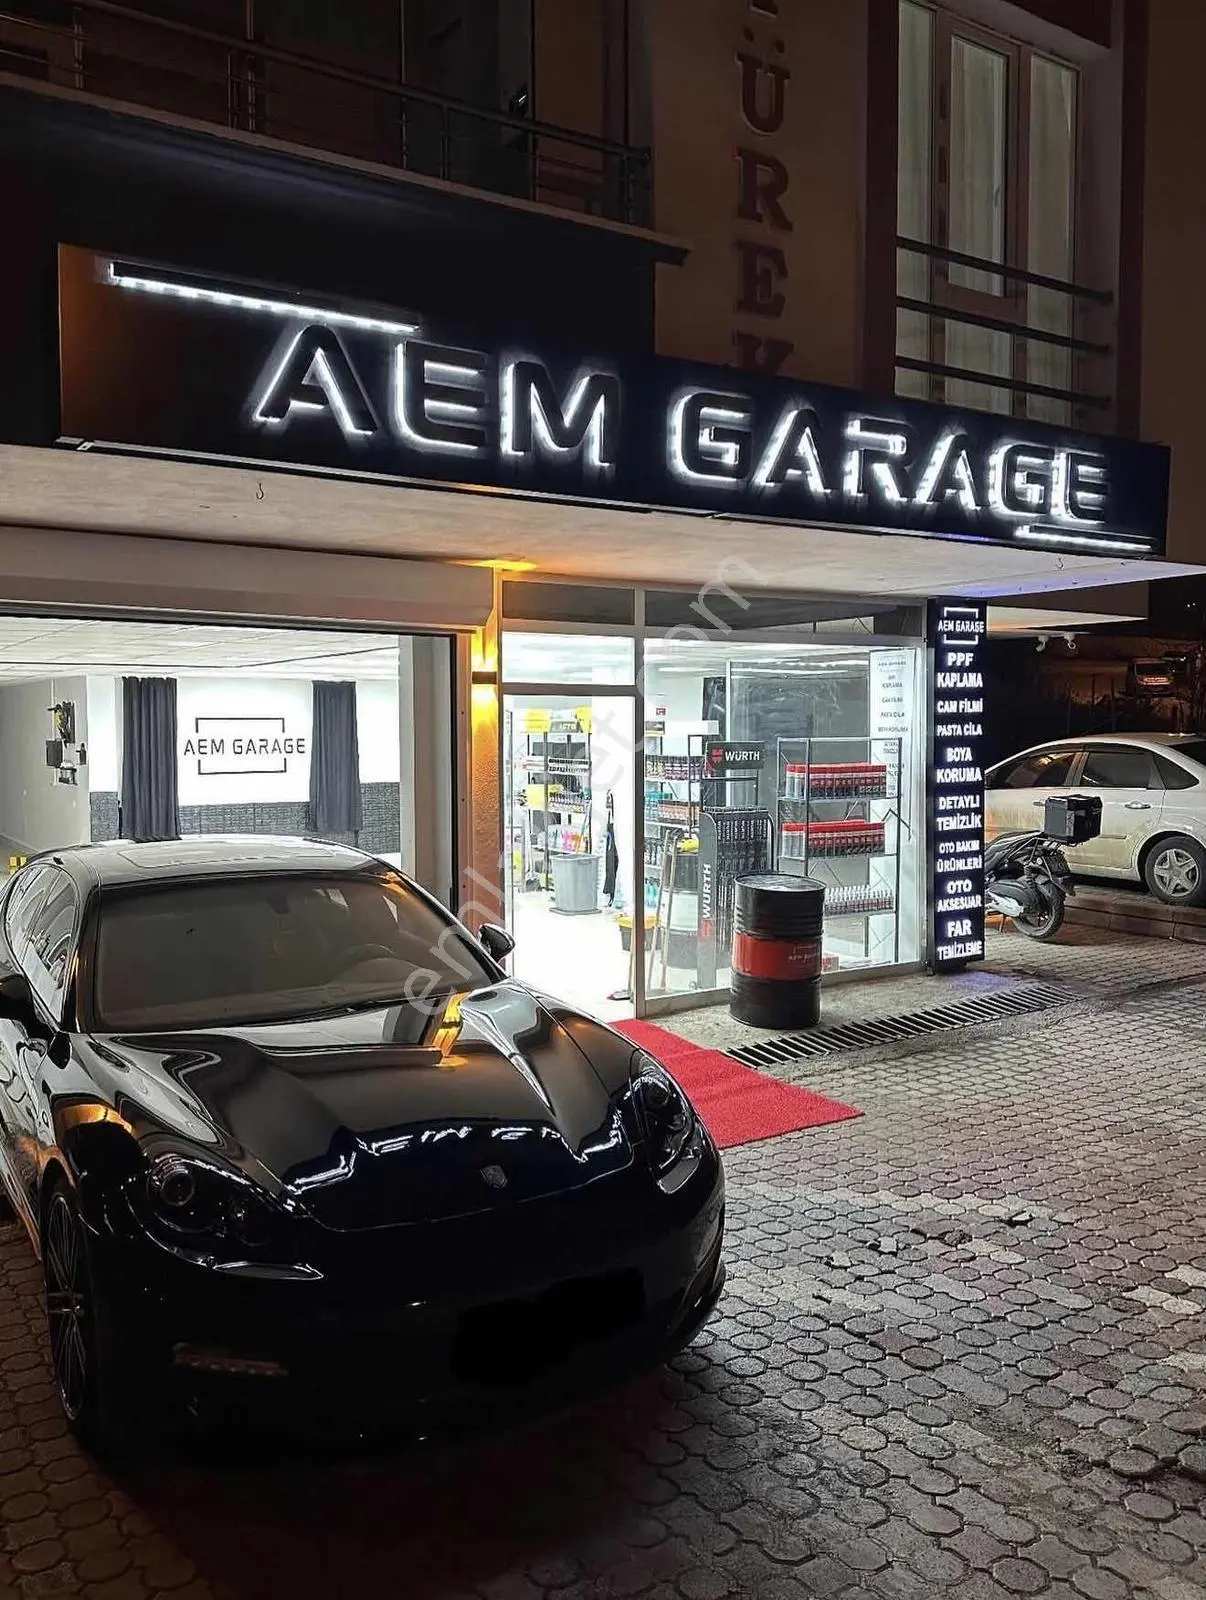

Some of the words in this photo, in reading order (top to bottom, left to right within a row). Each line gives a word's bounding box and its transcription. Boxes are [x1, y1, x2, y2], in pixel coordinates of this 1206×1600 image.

[252, 324, 619, 467] AEM
[669, 390, 1110, 526] GARAGE
[938, 620, 954, 632] AEM
[956, 620, 984, 633] GARAGE
[947, 652, 974, 667] PPF
[937, 672, 983, 688] KAPLAMA
[937, 700, 957, 713] CAM
[959, 698, 983, 713] FİLMİ
[937, 724, 962, 737] PASTA
[963, 721, 983, 736] CİLA
[183, 738, 225, 756] AEM
[232, 738, 306, 755] GARAGE
[947, 747, 972, 762] BOYA
[936, 766, 982, 783] KORUMA
[939, 795, 980, 810] DETAYLI
[936, 812, 982, 831] TEMİZLİK
[939, 841, 955, 854] OTO
[955, 840, 980, 852] BAKIM
[937, 855, 982, 873] ÜRÜNLERİ
[947, 878, 972, 894] OTO
[937, 895, 982, 913] AKSESUAR
[947, 919, 972, 938] FAR
[937, 940, 982, 960] TEMİZLEME
